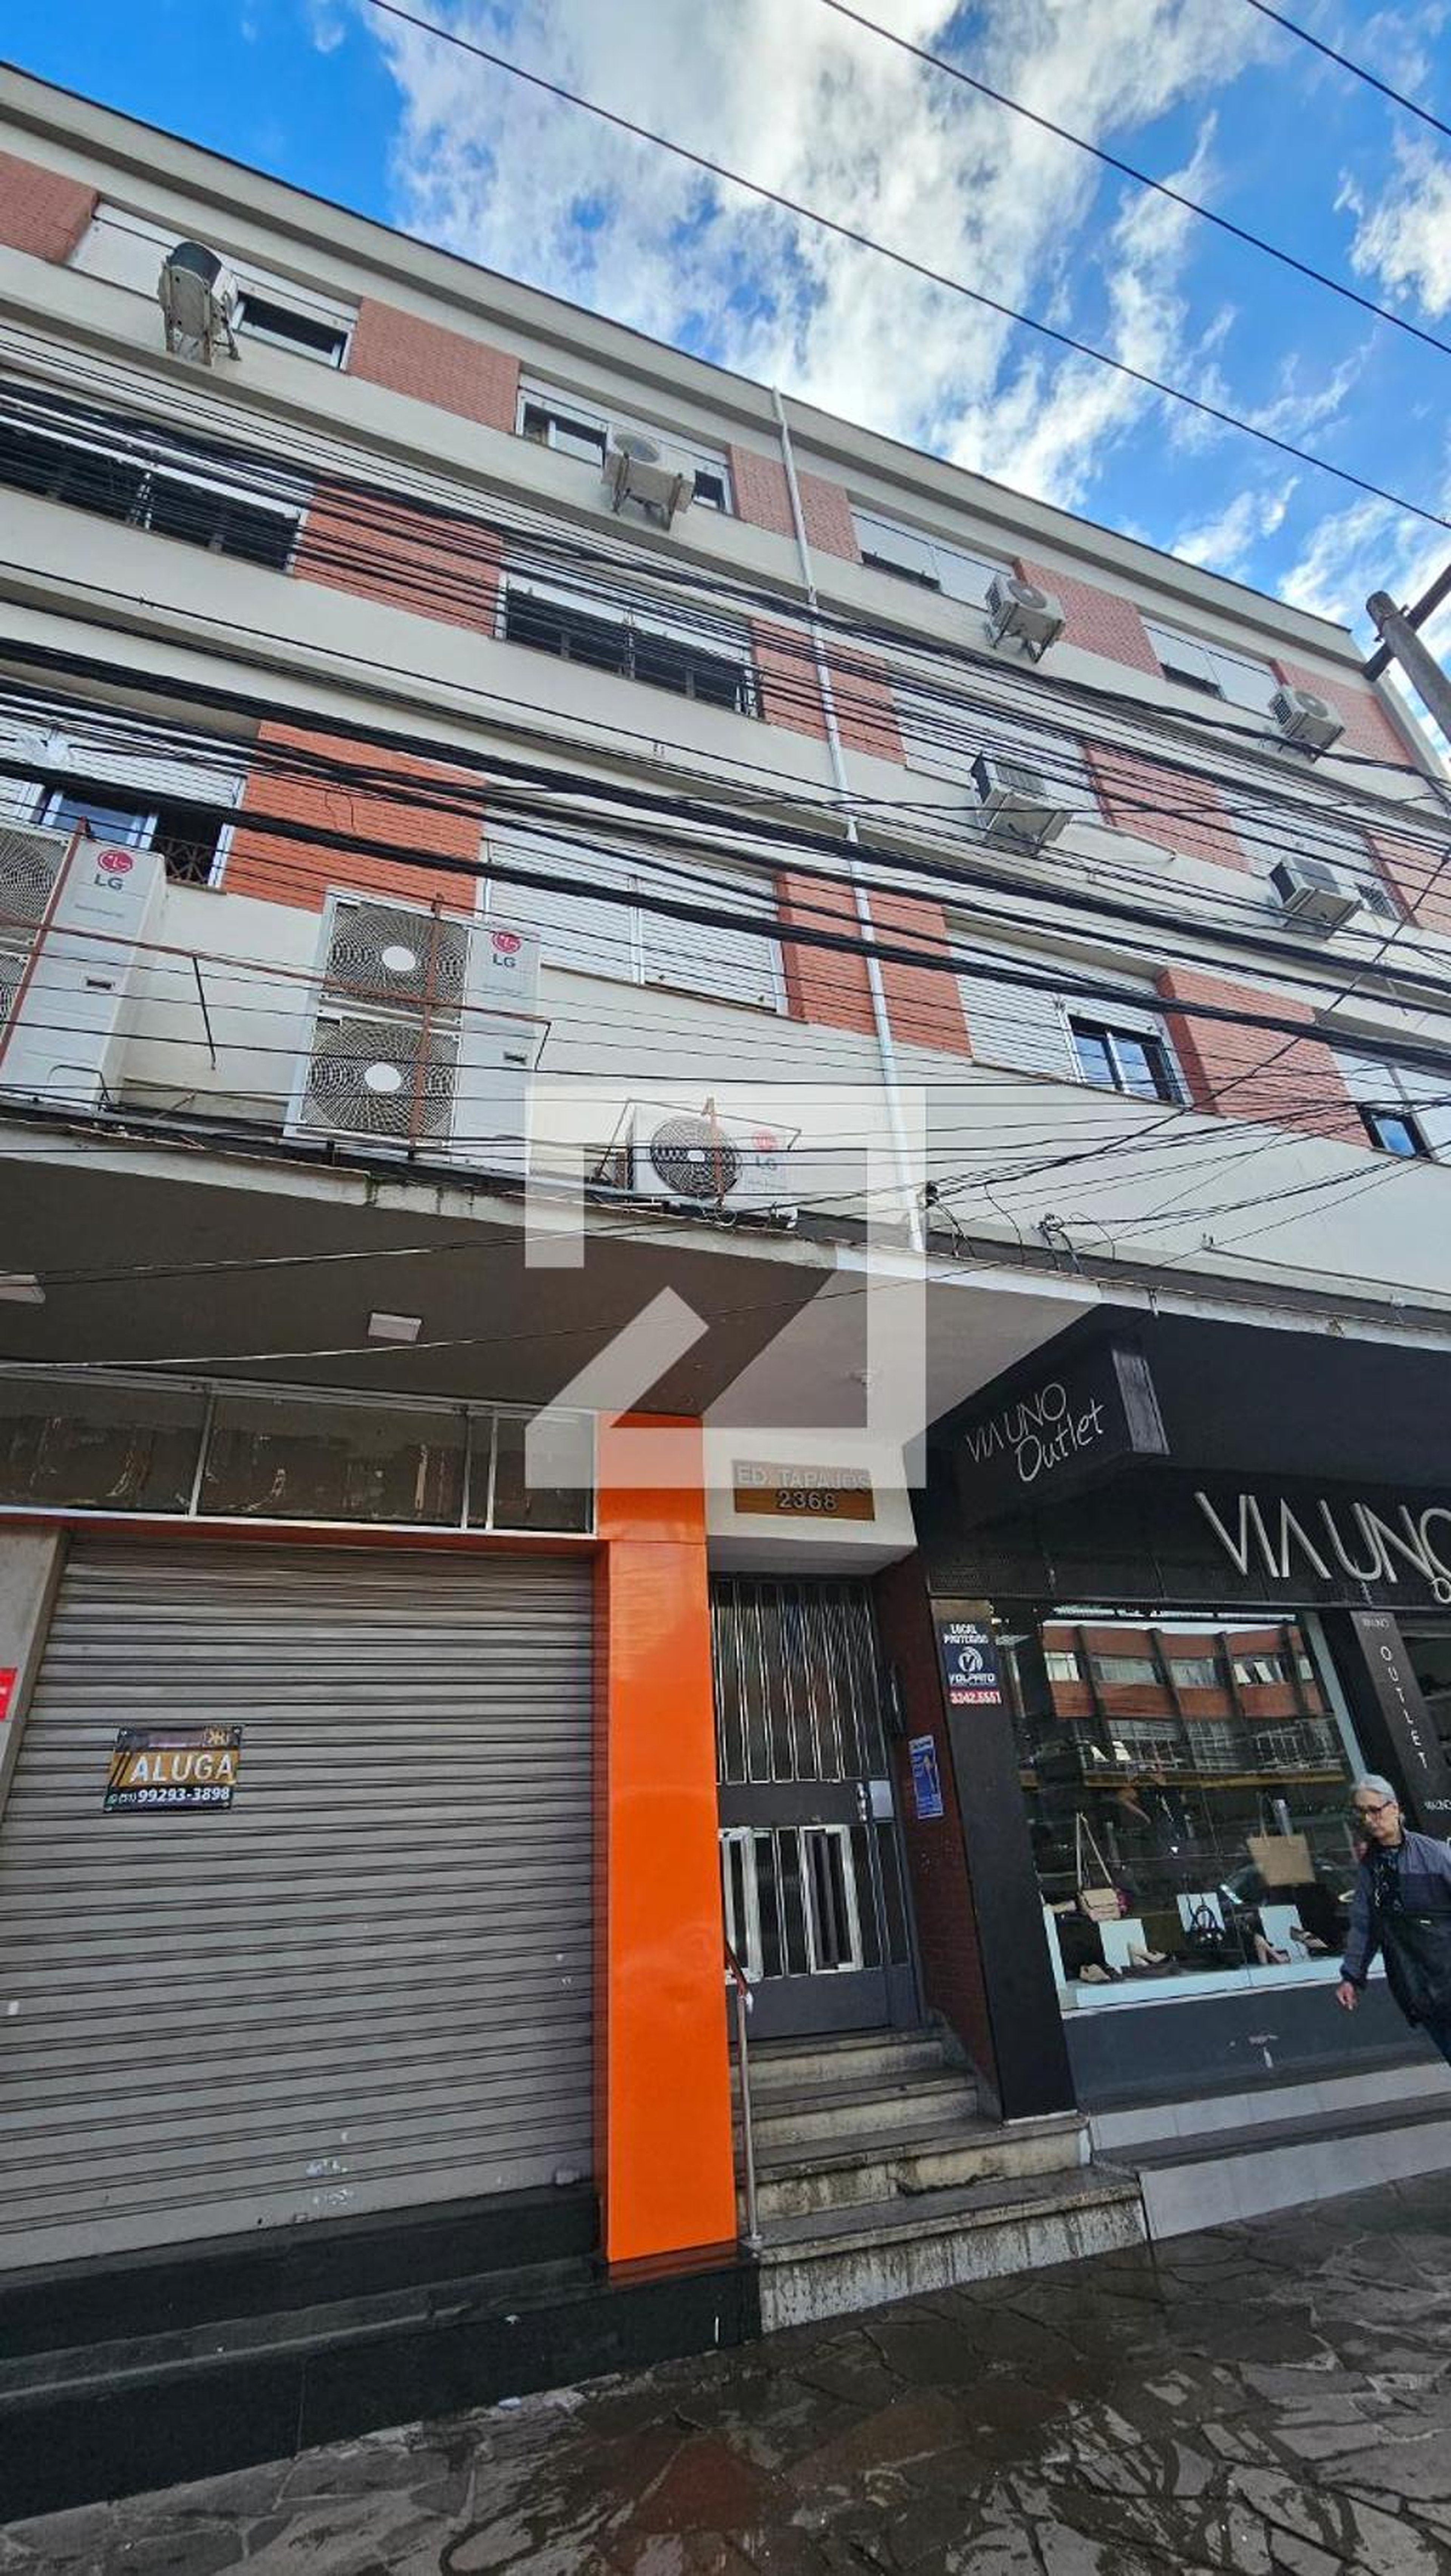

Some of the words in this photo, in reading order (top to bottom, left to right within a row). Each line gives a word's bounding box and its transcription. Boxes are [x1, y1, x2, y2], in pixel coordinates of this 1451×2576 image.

[94, 874, 123, 890] LG
[493, 954, 515, 968] LG
[1015, 1398, 1104, 1481] Outlet
[778, 1490, 837, 1511] 2368
[129, 1754, 234, 1783] ALUGA
[138, 1787, 230, 1802] 99293-3898
